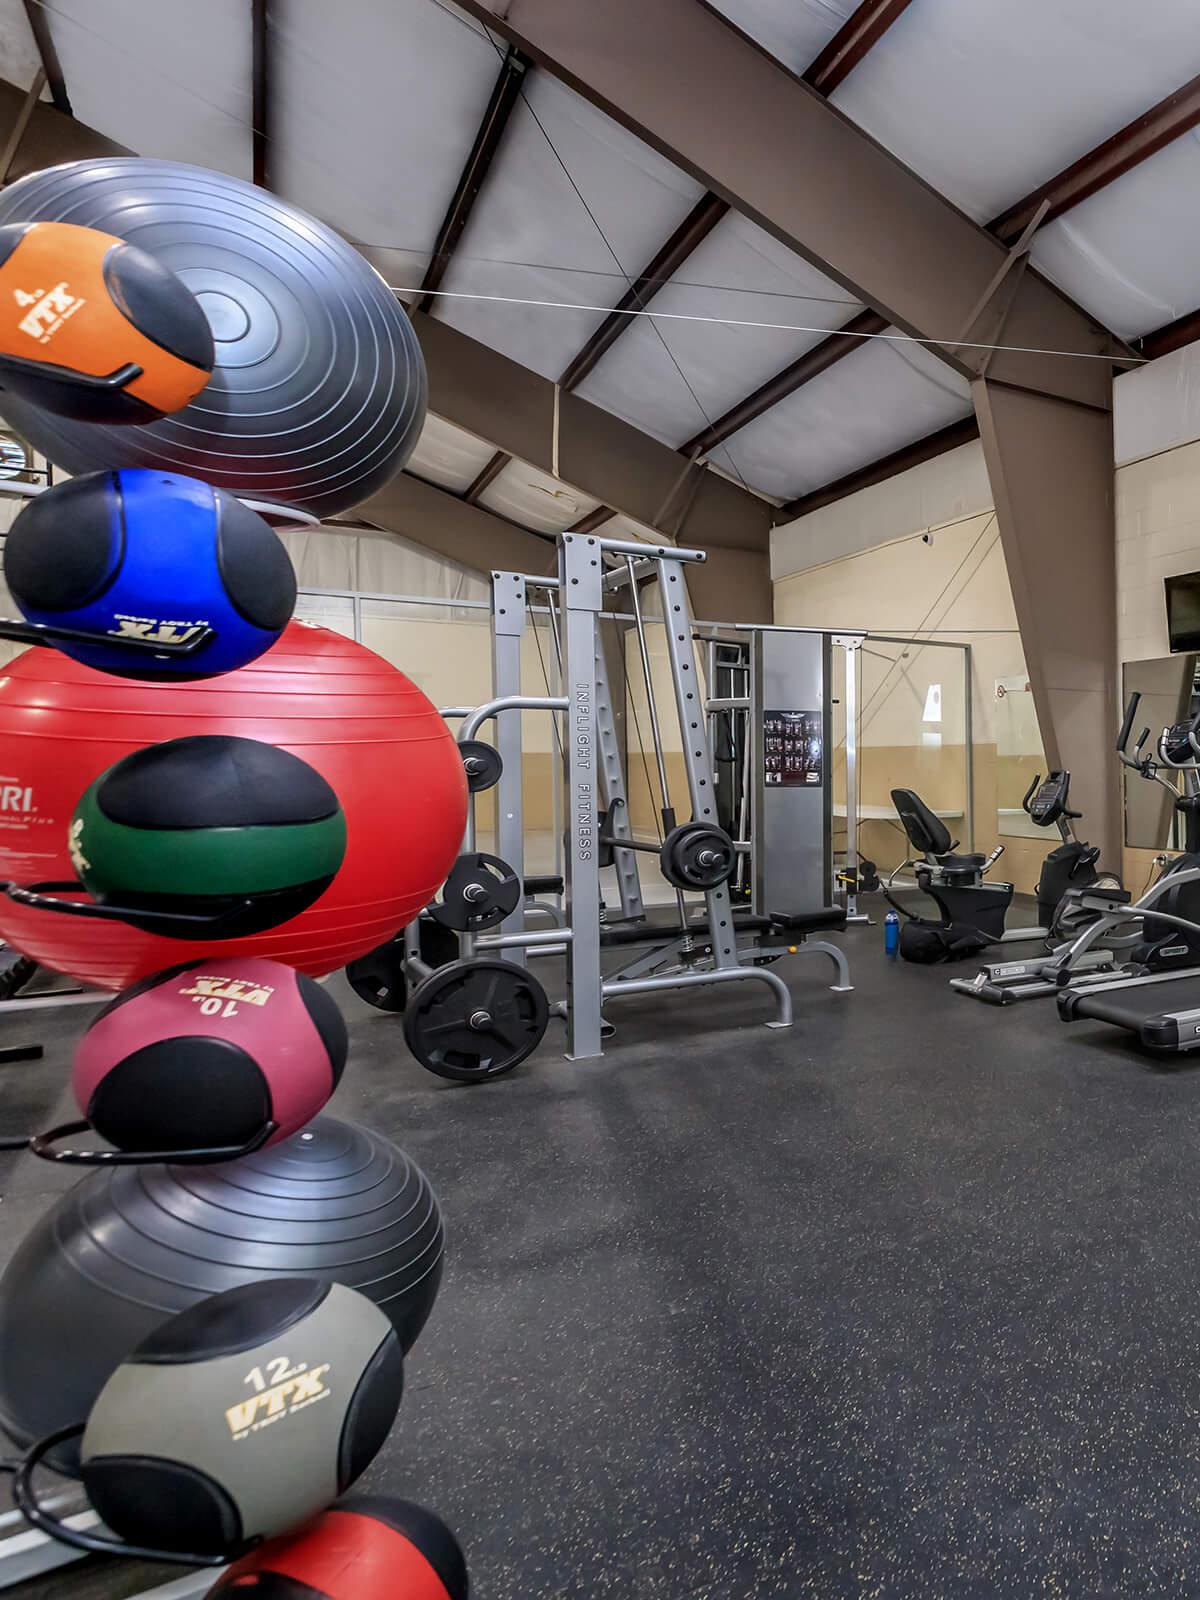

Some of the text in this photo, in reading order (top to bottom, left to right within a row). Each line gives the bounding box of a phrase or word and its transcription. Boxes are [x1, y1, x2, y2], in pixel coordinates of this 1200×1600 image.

[0, 785, 33, 812] RI
[576, 683, 592, 861] INFLIGHT FITNESS
[225, 1366, 326, 1434] VTX
